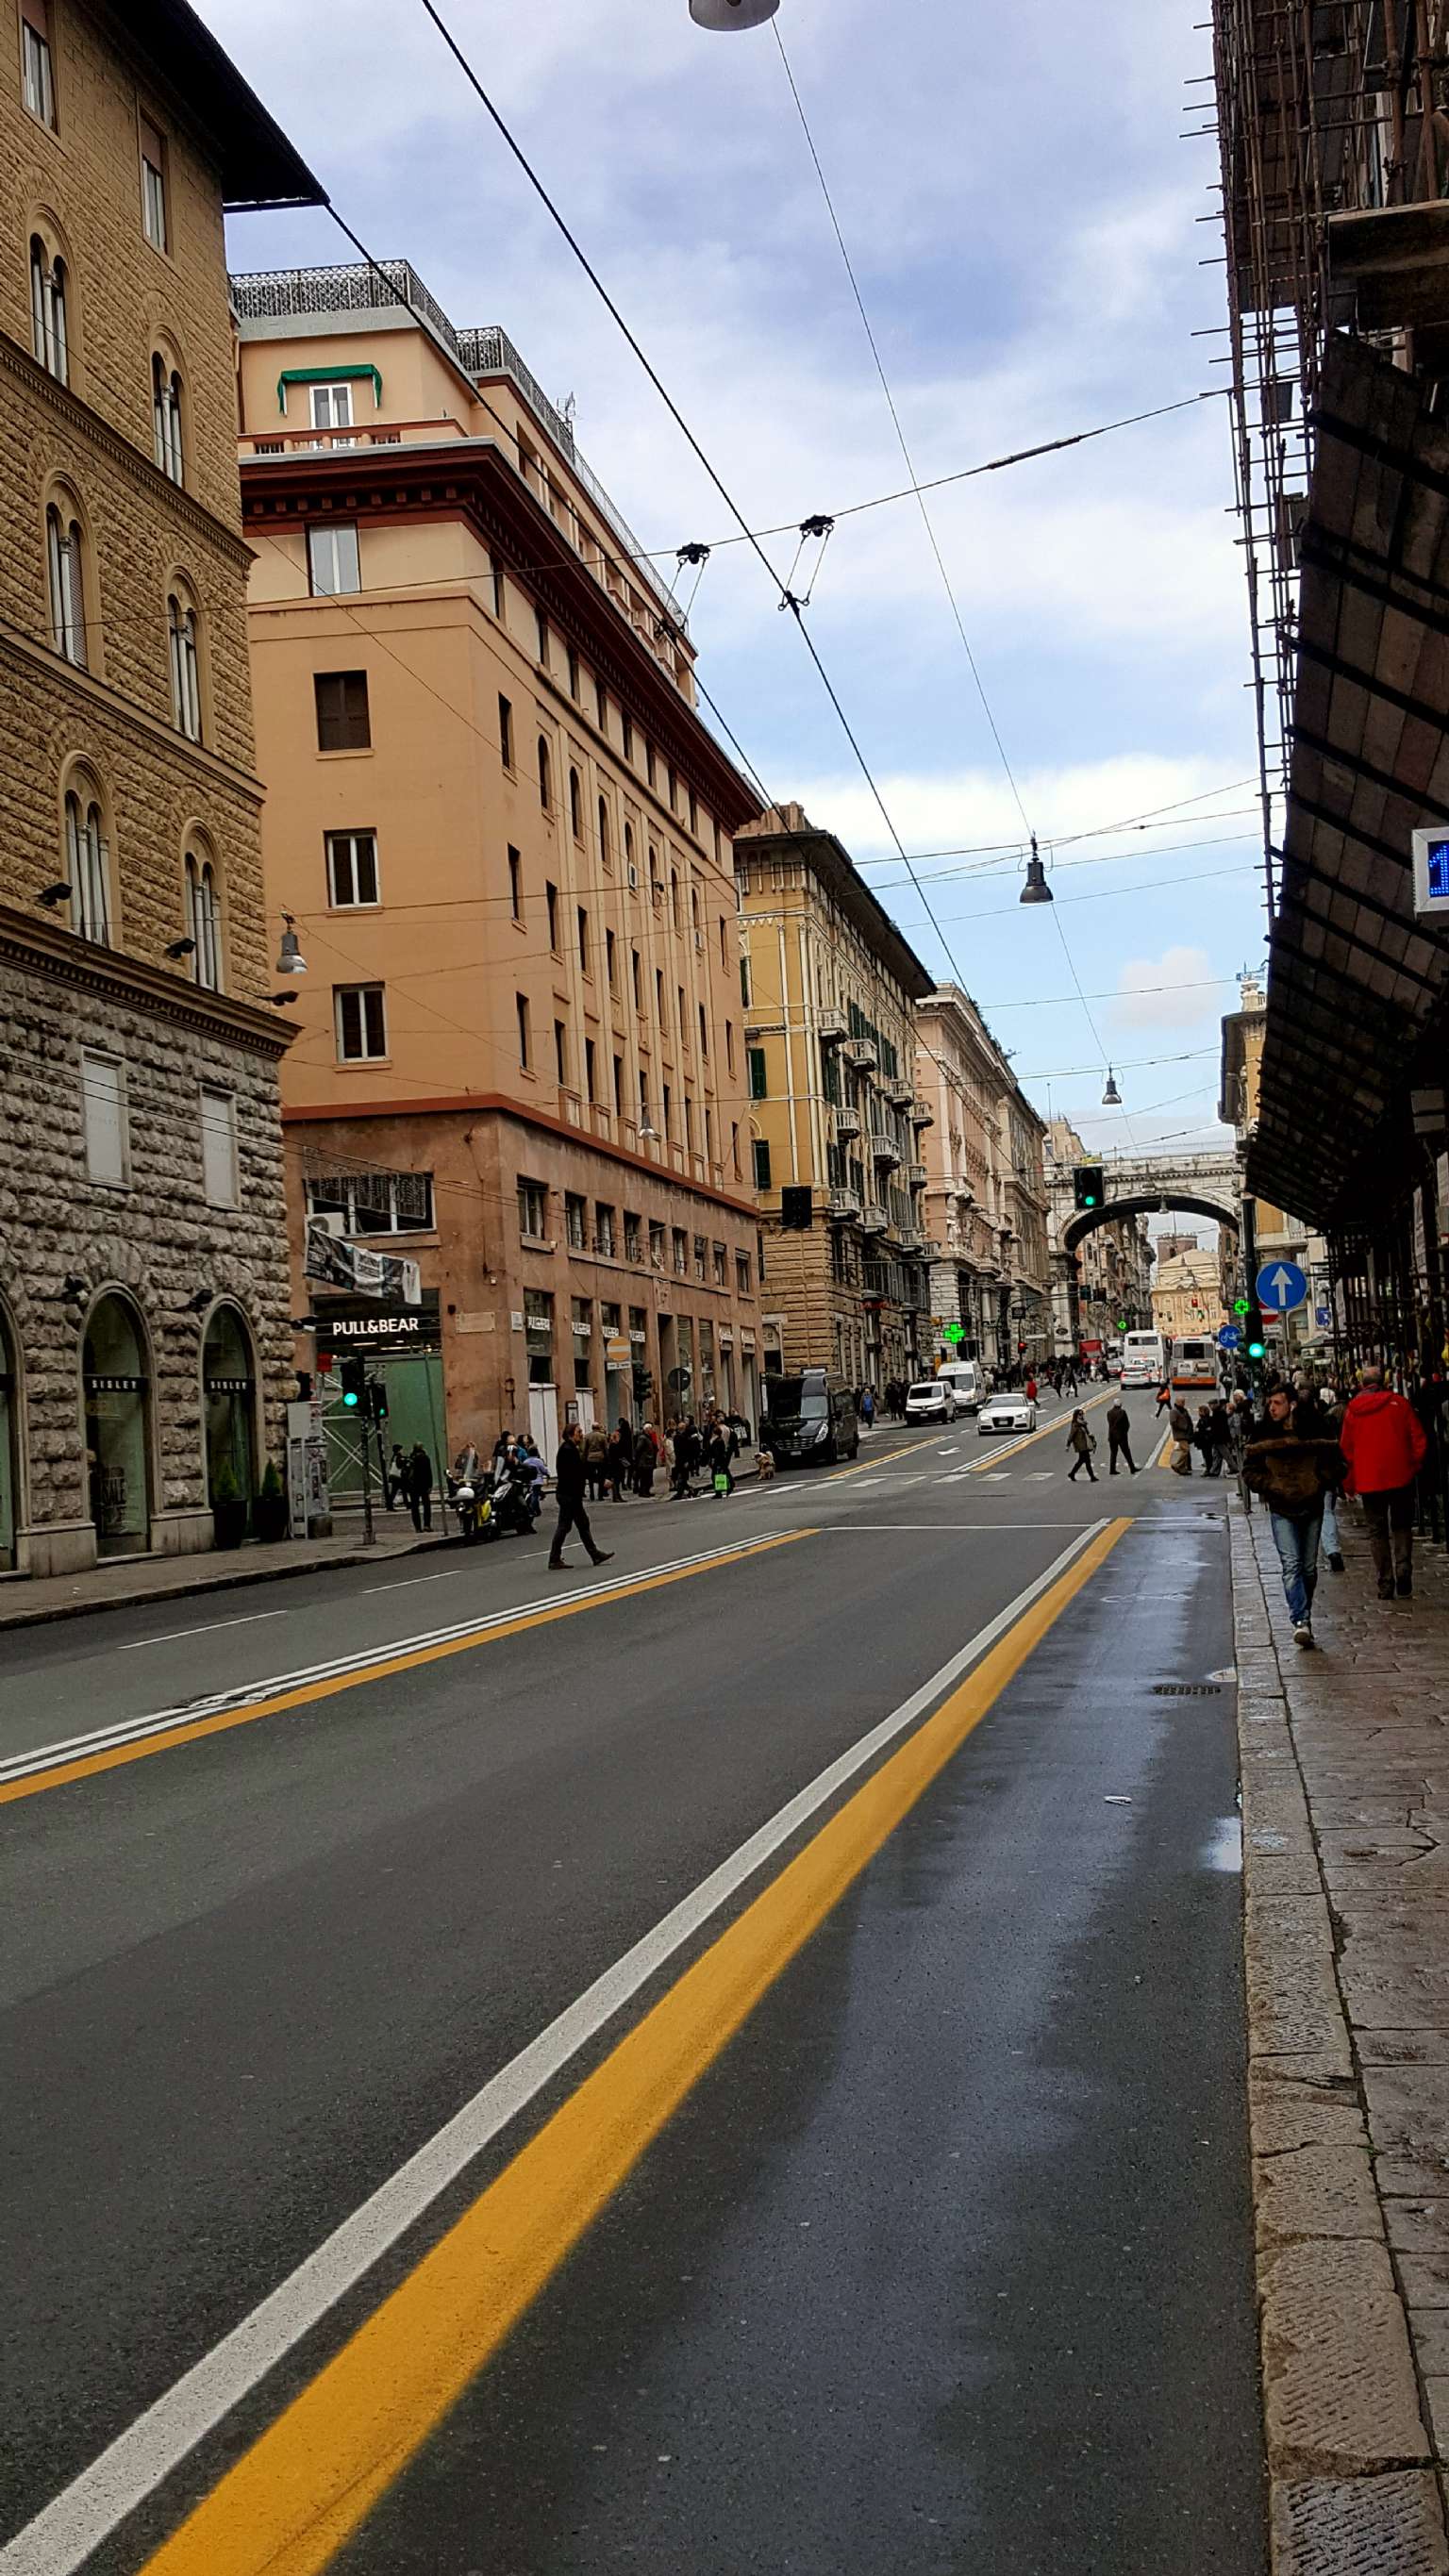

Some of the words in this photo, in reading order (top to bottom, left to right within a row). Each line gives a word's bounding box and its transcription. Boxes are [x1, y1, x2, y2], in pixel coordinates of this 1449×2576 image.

[332, 1317, 420, 1336] PULL&BEAR
[92, 1380, 137, 1389] SISLEY
[210, 1381, 247, 1390] SISLEY
